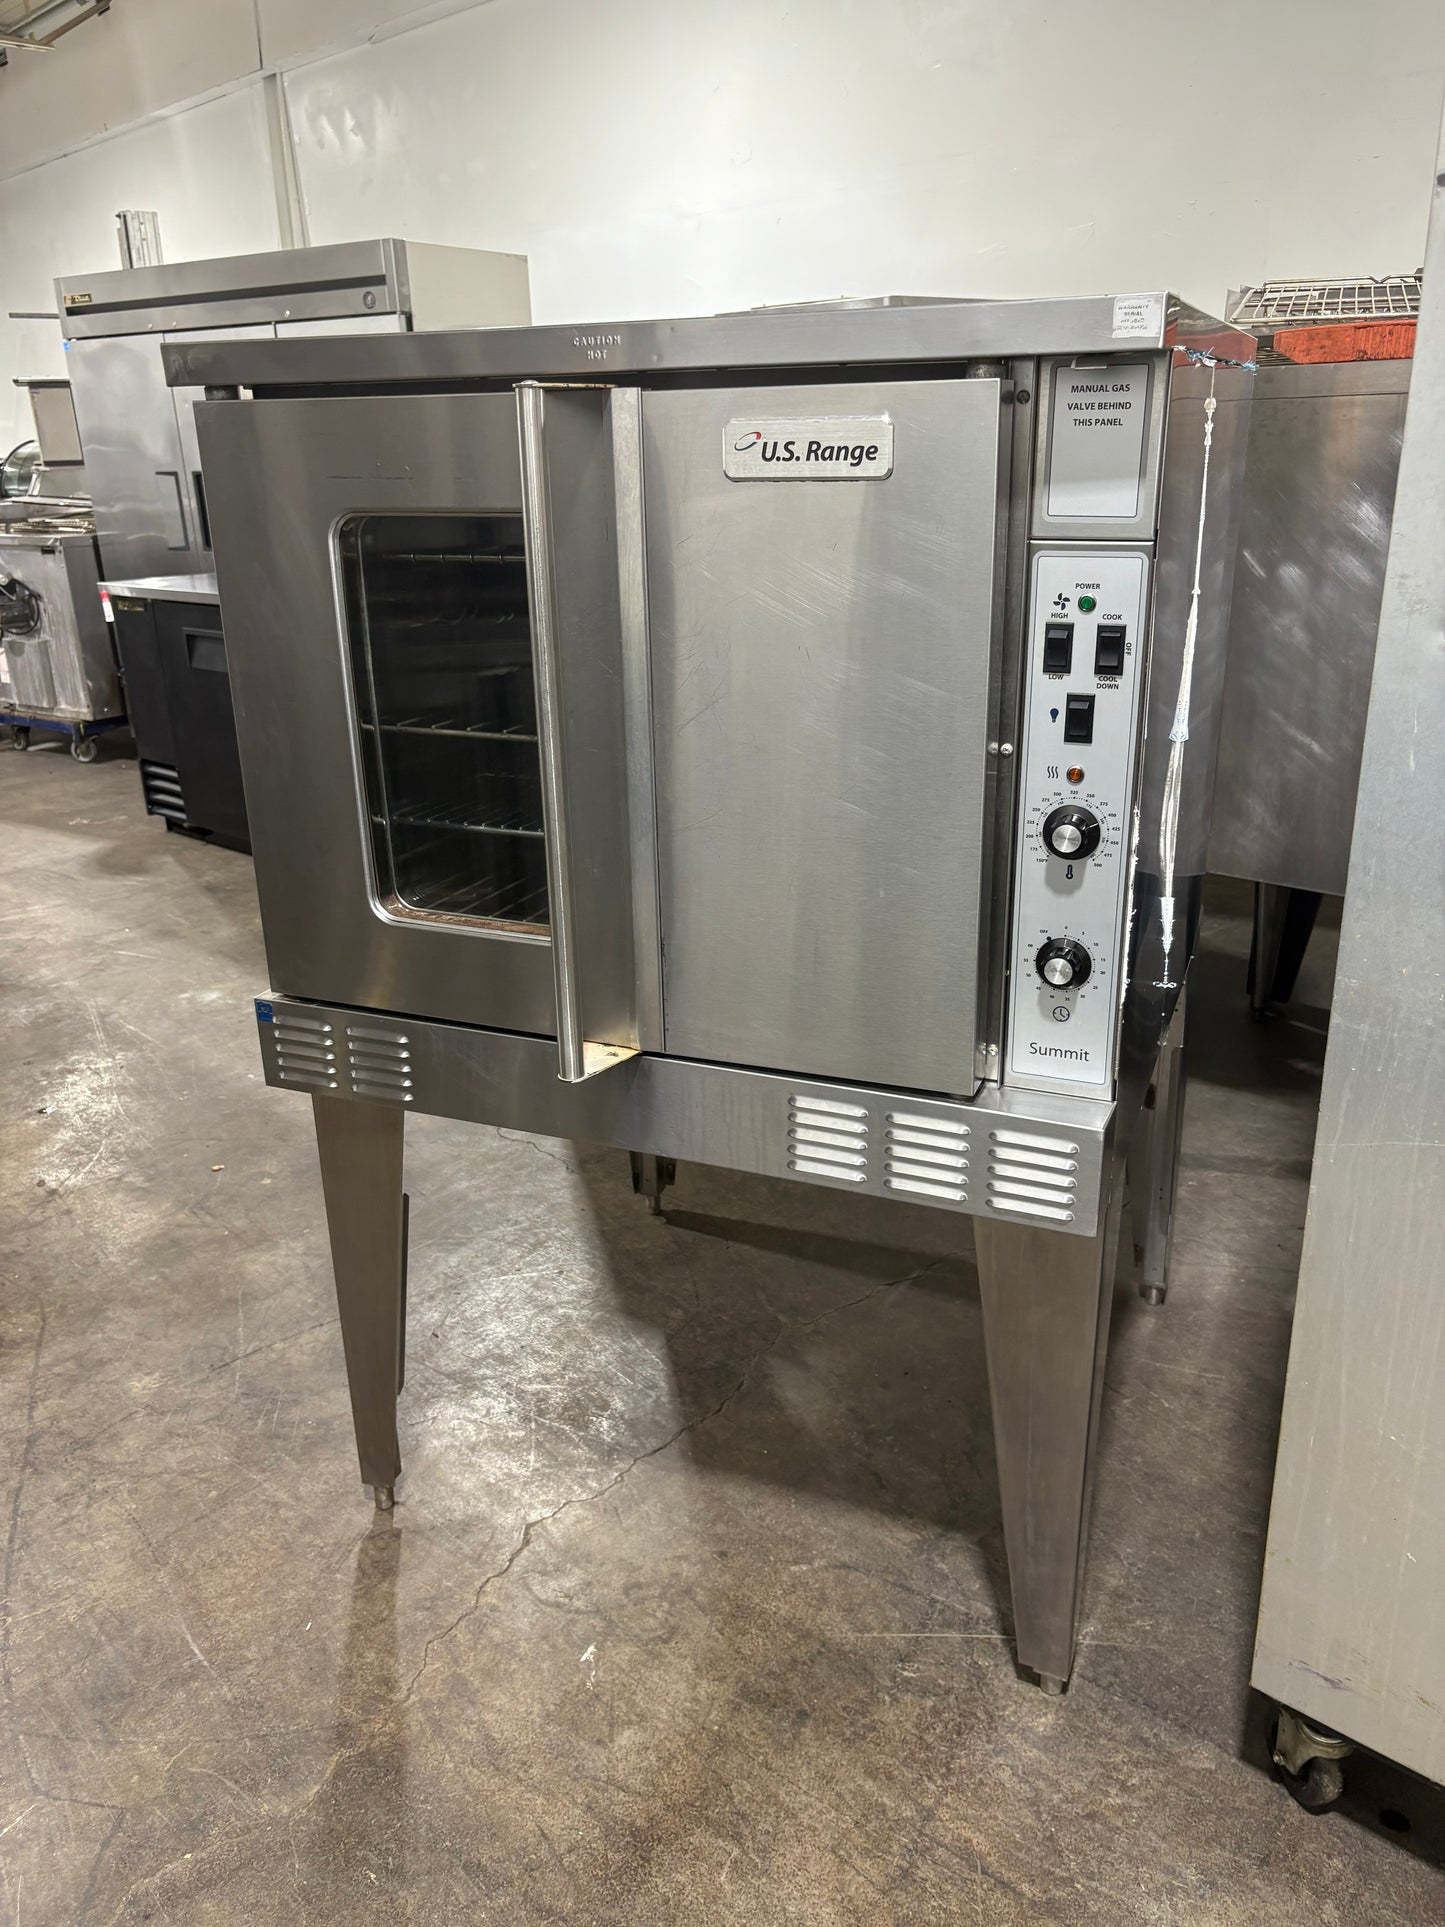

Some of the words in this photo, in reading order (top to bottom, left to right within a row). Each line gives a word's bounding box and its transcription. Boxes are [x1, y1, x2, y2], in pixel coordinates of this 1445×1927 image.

[573, 335, 621, 346] CAUTION
[587, 350, 607, 360] HOT
[1070, 384, 1110, 393] MANUAL
[1112, 384, 1130, 392] GAS
[1067, 402, 1096, 410] VALVE
[1098, 402, 1132, 410] BEHIND
[1073, 418, 1092, 426] THIS
[1094, 418, 1123, 426] PANEL
[761, 441, 800, 462] U.S.
[806, 440, 878, 467] Range
[1029, 1042, 1090, 1062] Summit
